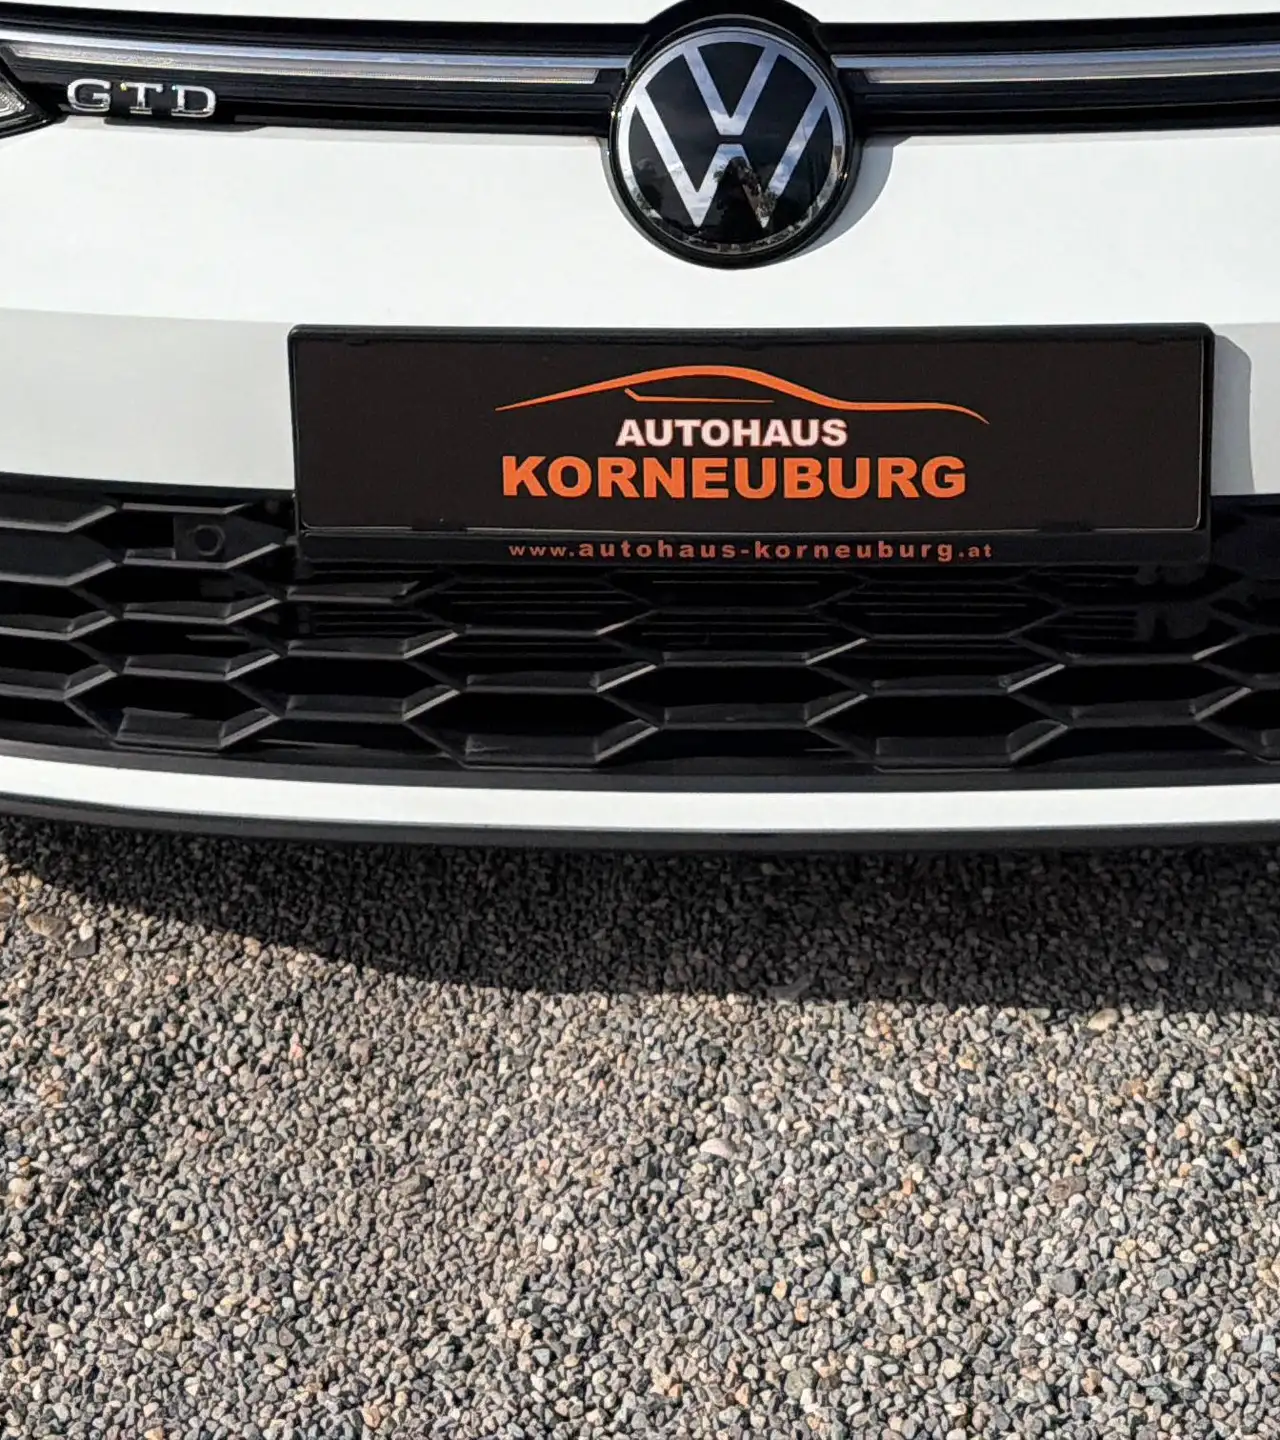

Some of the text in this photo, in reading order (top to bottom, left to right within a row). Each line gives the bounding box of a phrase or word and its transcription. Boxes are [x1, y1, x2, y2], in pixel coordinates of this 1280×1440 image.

[66, 77, 218, 119] GTD
[615, 417, 849, 448] AUTOHAUS
[501, 454, 967, 500] KORNEUBURG
[508, 539, 994, 563] www.autohaus-korneuburg.at
